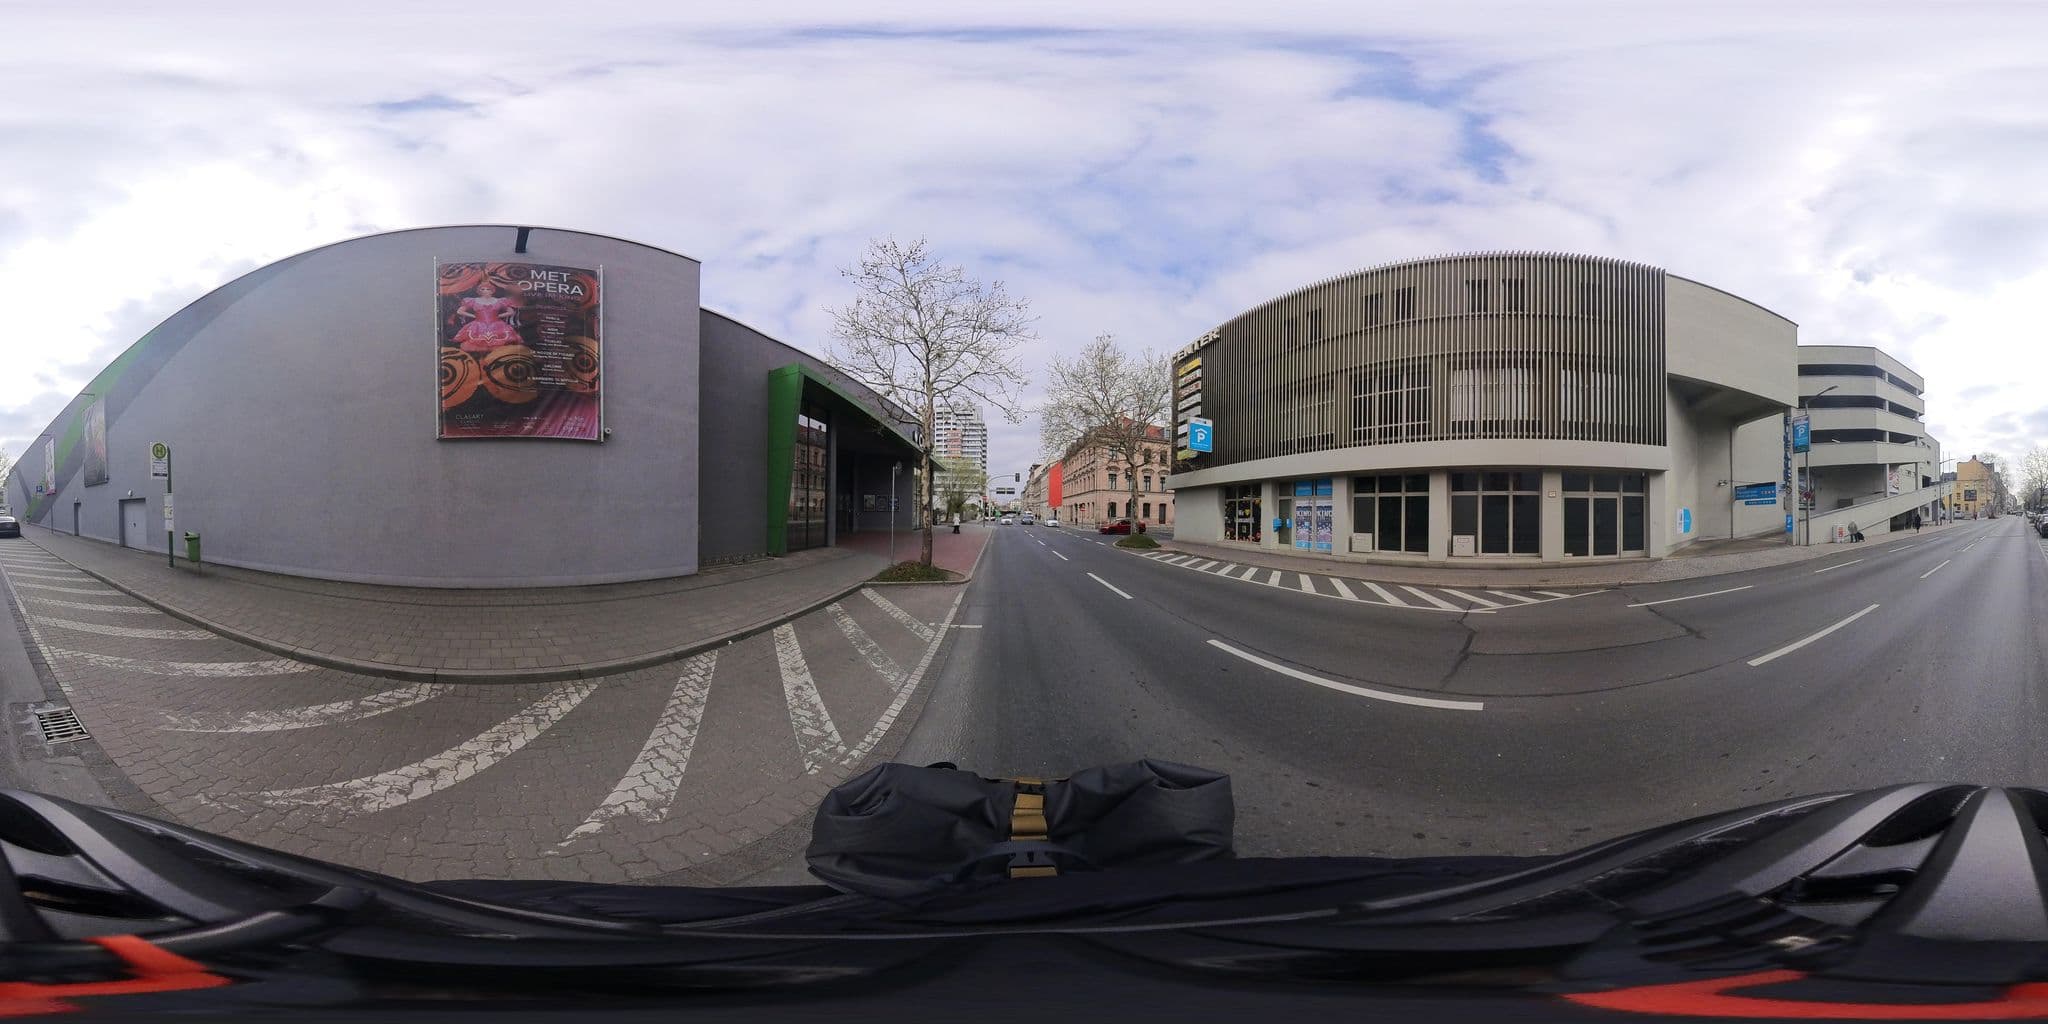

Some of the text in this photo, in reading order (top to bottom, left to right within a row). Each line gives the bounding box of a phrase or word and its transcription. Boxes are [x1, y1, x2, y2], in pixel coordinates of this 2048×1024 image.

[530, 270, 571, 282] MET
[517, 280, 584, 295] OPERA
[1197, 432, 1206, 443] P
